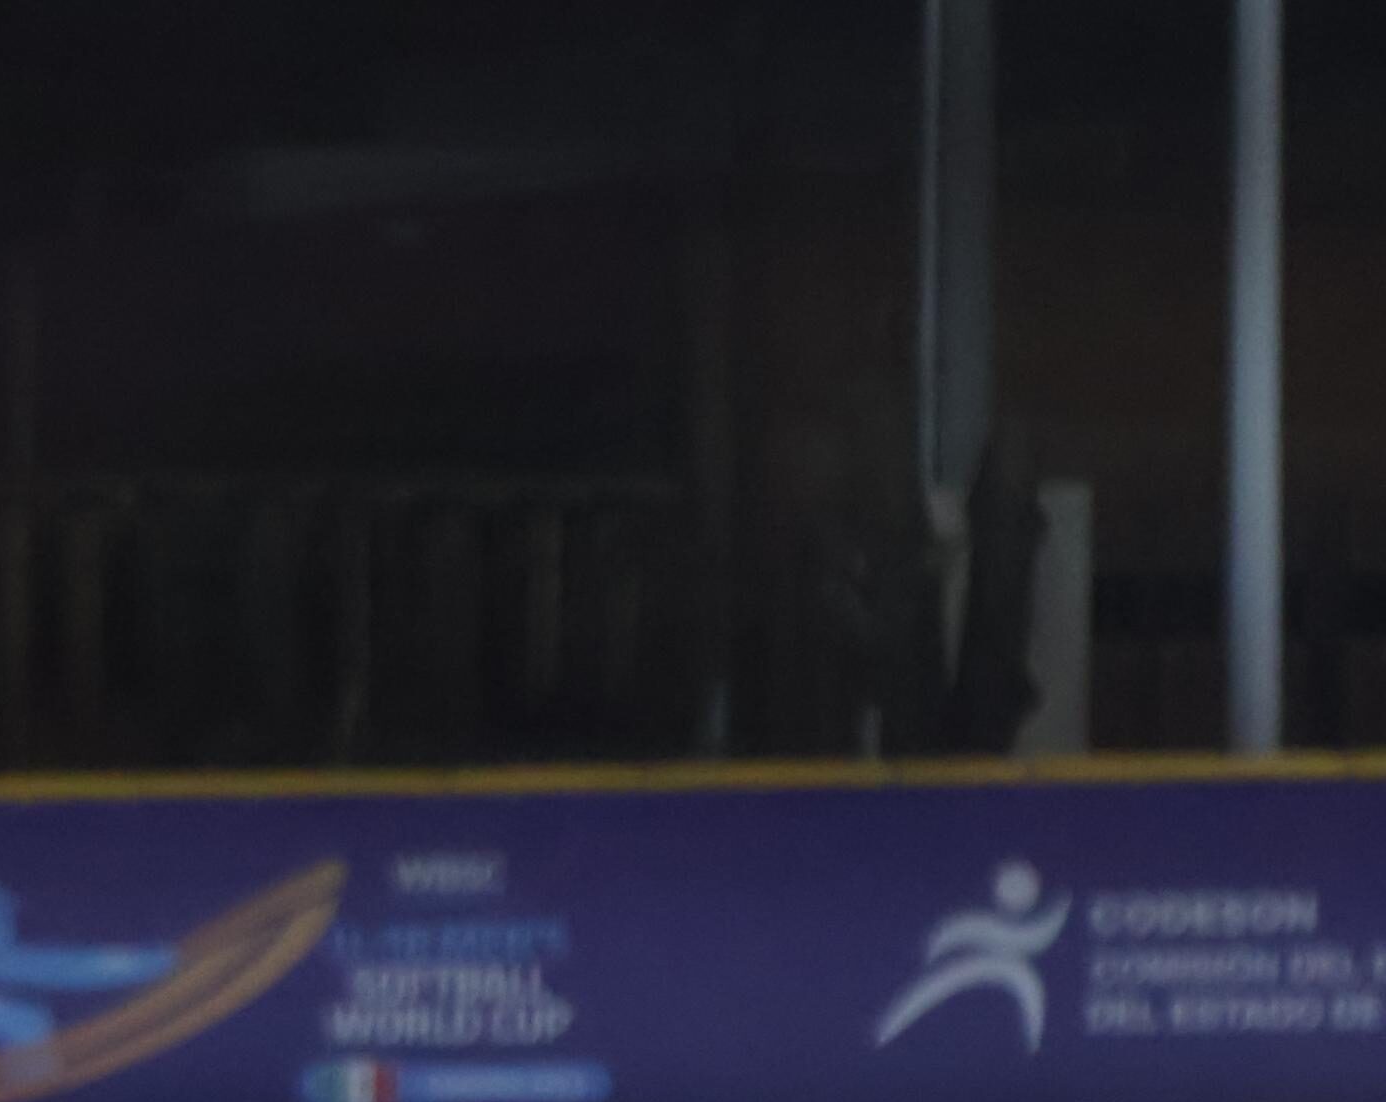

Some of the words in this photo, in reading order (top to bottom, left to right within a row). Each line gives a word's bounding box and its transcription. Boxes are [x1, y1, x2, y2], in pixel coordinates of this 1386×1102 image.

[1089, 890, 1319, 938] CODESON
[330, 1003, 484, 1045] WORLD
[490, 1000, 575, 1045] CUP
